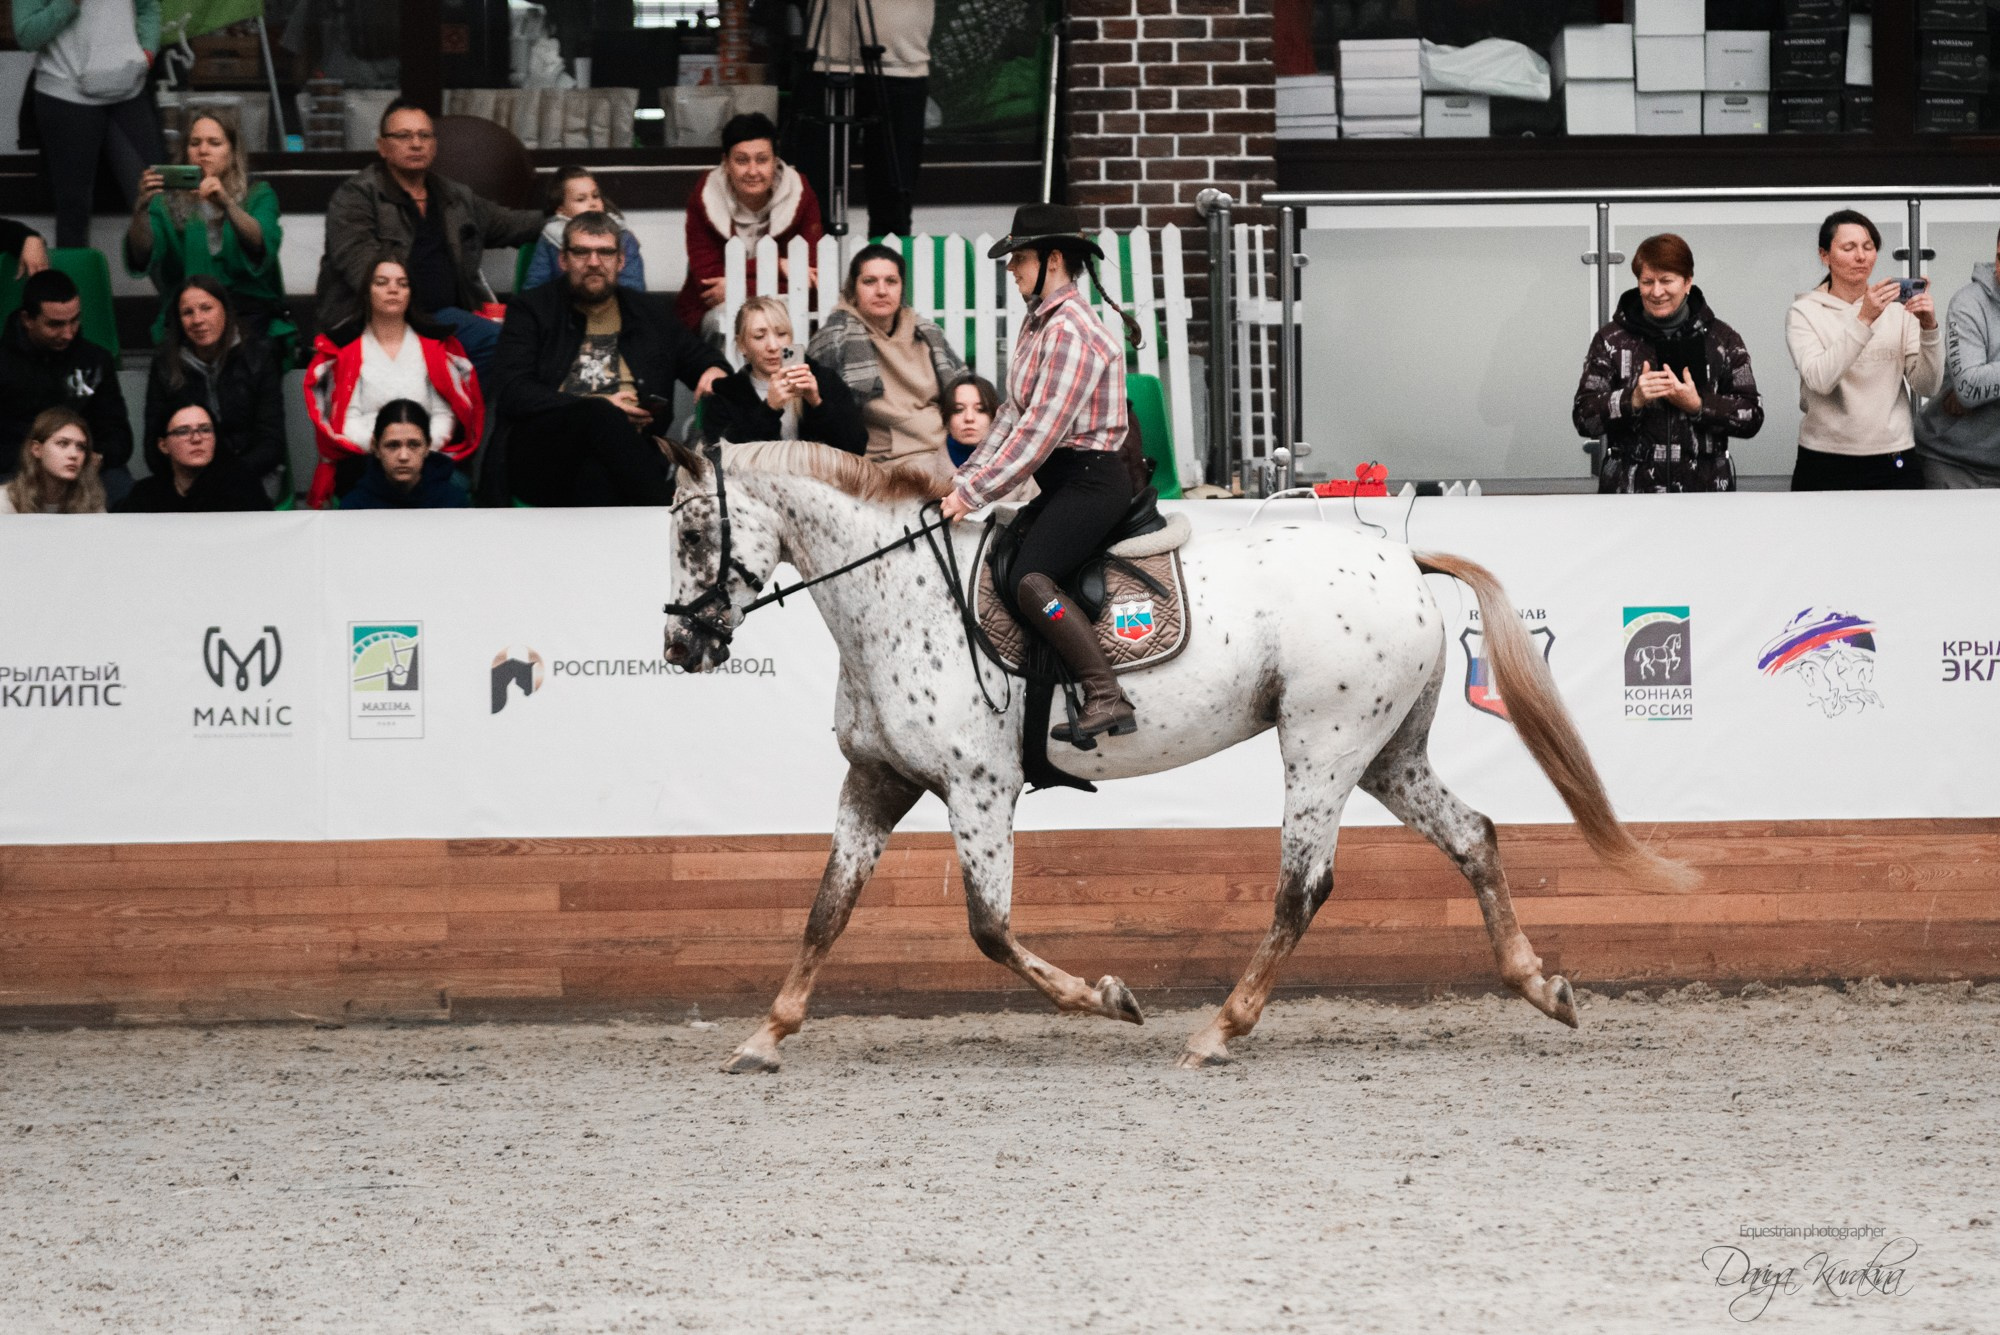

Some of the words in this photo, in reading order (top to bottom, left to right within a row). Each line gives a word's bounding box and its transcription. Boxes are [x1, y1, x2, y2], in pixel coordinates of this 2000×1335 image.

[1958, 380, 2000, 401] GAMES
[1469, 609, 1547, 620] RNAB
[553, 658, 776, 677] РОСПЛЕМКОАВОД
[3, 684, 122, 707] КЛИПС
[1624, 688, 1692, 700] КОННАЯ
[362, 702, 411, 711] MAXIMA
[1625, 704, 1693, 716] РОССИЯ
